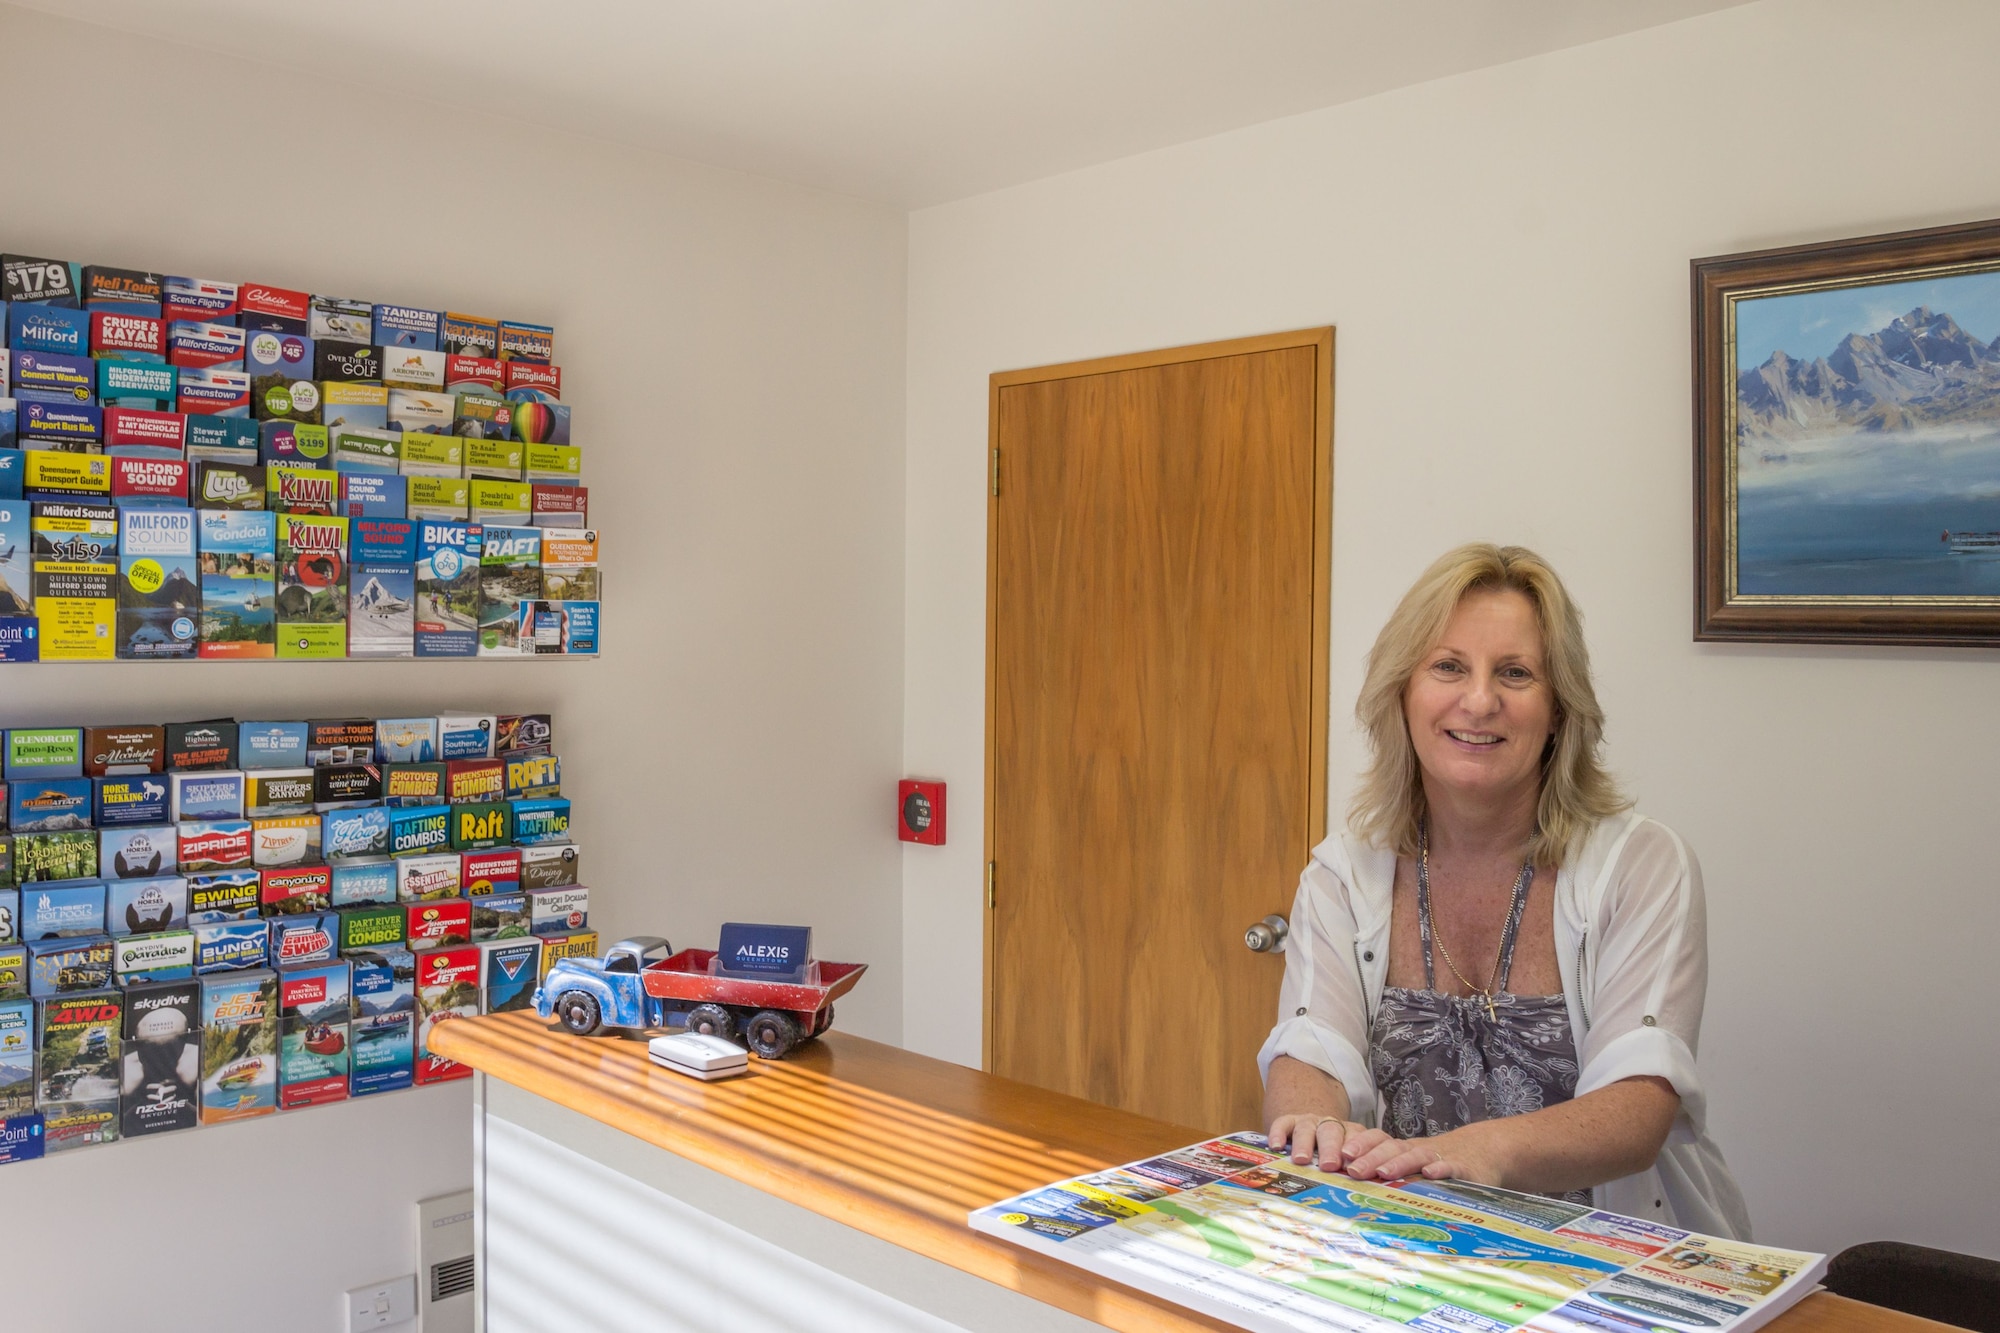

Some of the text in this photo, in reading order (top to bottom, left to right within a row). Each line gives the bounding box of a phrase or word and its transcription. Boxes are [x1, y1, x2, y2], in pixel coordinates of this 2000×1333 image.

[6, 264, 67, 292] $179
[92, 275, 160, 295] Heli Tours
[12, 288, 70, 300] MILFORD SOUND
[170, 295, 196, 305] Scenic
[198, 298, 225, 309] Flights
[382, 307, 437, 321] TANDEM
[28, 314, 71, 328] Cruise
[103, 316, 159, 332] CRUISE &
[382, 316, 436, 328] PARAGLIDING
[22, 325, 78, 344] Milford
[103, 327, 158, 343] KAYAK
[445, 322, 495, 340] tandem
[102, 338, 157, 350] MILFORD SOUND
[502, 331, 551, 346] tandem
[178, 338, 234, 354] Milford Sound
[501, 341, 551, 357] paragliding
[36, 364, 76, 373] Queenstown
[109, 366, 171, 378] MILFORD SOUND
[342, 363, 377, 377] GOLF
[392, 368, 435, 378] ARROWTOWN
[454, 363, 502, 378] hang gliding
[21, 370, 89, 384] Connect Wanaka
[109, 374, 171, 385] UNDERWATER
[512, 372, 556, 384] paragliding
[108, 381, 171, 392] OBSERVATORY
[183, 387, 236, 399] Queenstown
[47, 412, 88, 423] Queenstown
[30, 420, 96, 433] Airport Bus link
[125, 422, 137, 430] MT
[139, 424, 180, 433] NICHOLAS
[193, 427, 227, 436] Stewart
[134, 430, 161, 438] COUNTRY
[193, 435, 221, 445] Island
[300, 439, 325, 448] $199
[39, 465, 81, 475] Queenstown
[121, 461, 183, 476] MILFORD
[39, 474, 103, 486] Transport Guide
[127, 474, 177, 486] SOUND
[206, 470, 251, 499] Luge
[349, 477, 384, 486] MILFORD
[279, 478, 332, 502] KIWI
[349, 485, 376, 493] SOUND
[413, 483, 441, 491] Milford
[481, 492, 514, 500] Doubtful
[480, 499, 503, 507] Sound
[43, 505, 115, 519] Milford Sound
[129, 516, 188, 529] MILFORD
[358, 522, 411, 533] MILFORD
[129, 530, 188, 544] SOUND
[213, 525, 267, 541] Gondola
[288, 525, 341, 549] KIWI
[364, 534, 404, 544] SOUND
[424, 525, 466, 545] BIKE
[487, 530, 512, 540] PACK
[51, 538, 102, 562] $159
[484, 537, 539, 557] RAFT
[550, 543, 593, 551] QUEENSTOWN
[134, 564, 160, 578] SPECIAL
[49, 575, 107, 583] QUEENSTOWN
[131, 570, 160, 585] OFFER
[49, 582, 80, 590] MILFORD
[316, 726, 374, 735] SCENIC TOURS
[14, 735, 76, 744] GLENORCHY
[185, 736, 220, 744] Highlands
[316, 735, 373, 744] QUEENSTOWN
[390, 772, 438, 781] SHOTOVER
[453, 768, 502, 781] QUEENSTOWN
[508, 757, 557, 790] RAFT
[103, 784, 129, 794] HORSE
[186, 783, 235, 793] SKIPPERS
[268, 784, 312, 792] SKIPPERS
[329, 777, 370, 789] wine trail
[389, 780, 438, 795] COMBOS
[453, 775, 502, 798] COMBOS
[103, 792, 143, 804] TREKKING
[268, 790, 305, 799] CANYON
[519, 811, 555, 820] WHITEWATER
[260, 820, 317, 829] ZIPLINING
[395, 816, 446, 836] RAFTING
[461, 810, 504, 840] Raft
[520, 816, 568, 834] RAFTING
[183, 836, 247, 854] ZIPRIDE
[395, 829, 446, 850] COMBOS
[36, 853, 82, 870] heaven
[470, 860, 517, 870] QUEENSTOWN
[469, 866, 517, 877] LAKE CRUISE
[530, 868, 562, 878] Dining
[268, 874, 327, 888] canyoning
[341, 877, 388, 889] WATER
[194, 885, 257, 904] SWING
[37, 910, 92, 921] HOT POOLS
[349, 915, 401, 929] DART RIVER
[429, 919, 466, 927] SHOTOVER
[349, 929, 400, 945] COMBOS
[422, 926, 448, 937] JET
[202, 938, 265, 956] BUNGY
[548, 942, 591, 957] JET BOAT
[736, 945, 789, 958] ALEXIS
[736, 956, 788, 964] QUEENSTOWN
[440, 965, 476, 974] SHOTOVER
[432, 973, 458, 984] JET
[222, 991, 262, 1006] JET
[288, 991, 323, 1000] FUNYAKS
[61, 999, 109, 1008] ORIGINAL
[133, 995, 190, 1010] skydive
[53, 1006, 120, 1024] 4WD
[215, 1001, 267, 1018] BOAT
[1, 1020, 26, 1029] SCENIC
[47, 1020, 112, 1032] ADVENTURES
[1385, 1193, 1485, 1224] Queenstown
[1634, 1267, 1725, 1295] NEW WORLD
[1623, 1299, 1706, 1326] QUEENSTOWN
